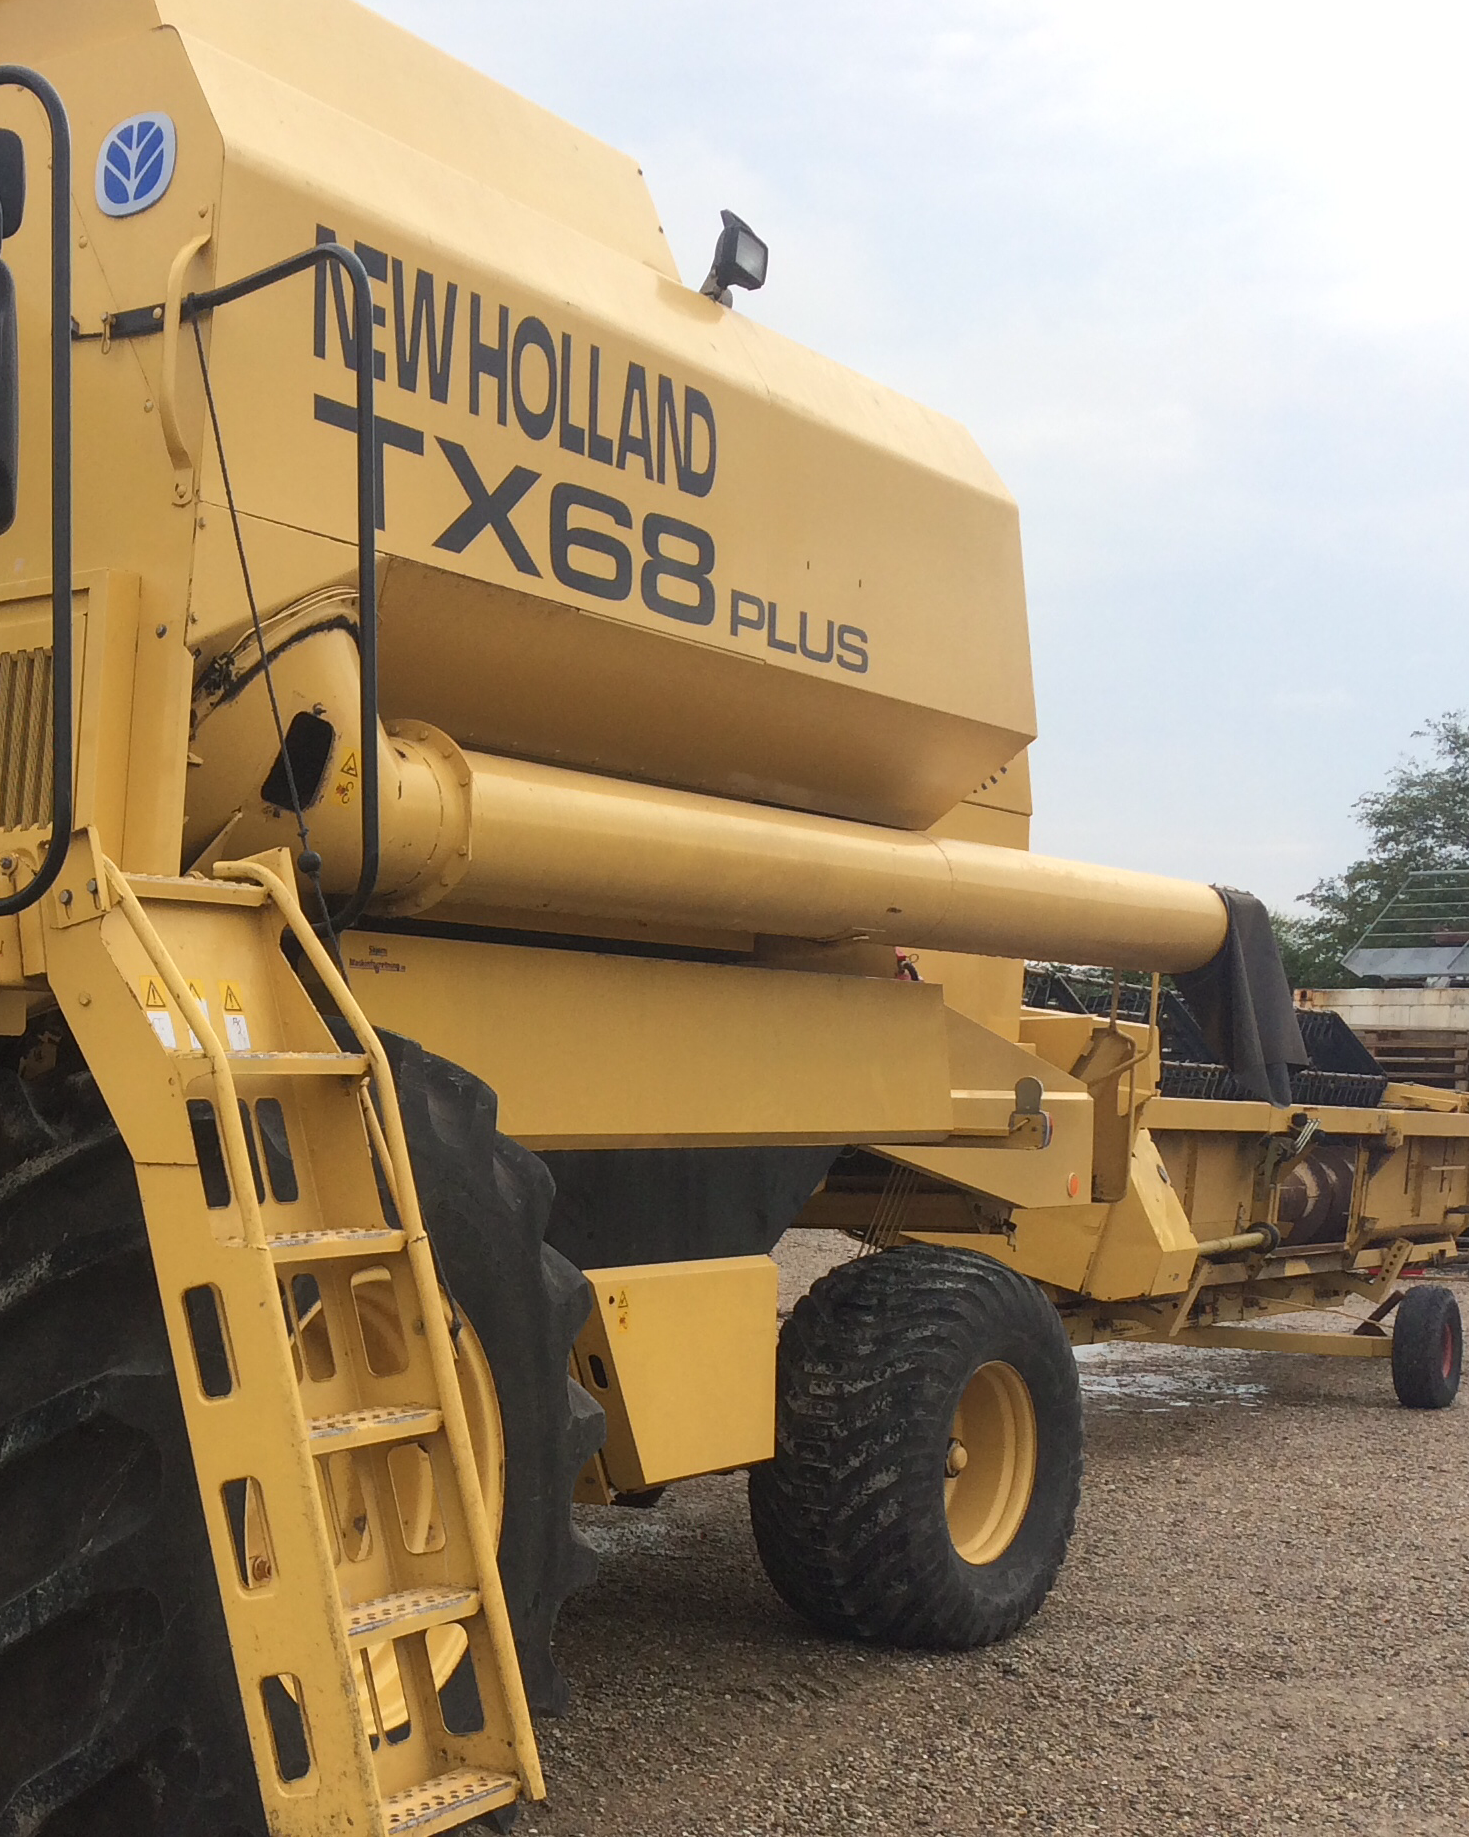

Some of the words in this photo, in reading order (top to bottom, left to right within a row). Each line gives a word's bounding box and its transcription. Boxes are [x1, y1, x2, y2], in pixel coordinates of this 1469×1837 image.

[313, 223, 458, 405] NEW
[469, 290, 717, 498] HOLLAND
[313, 393, 716, 626] TX68
[730, 589, 868, 674] PLUS
